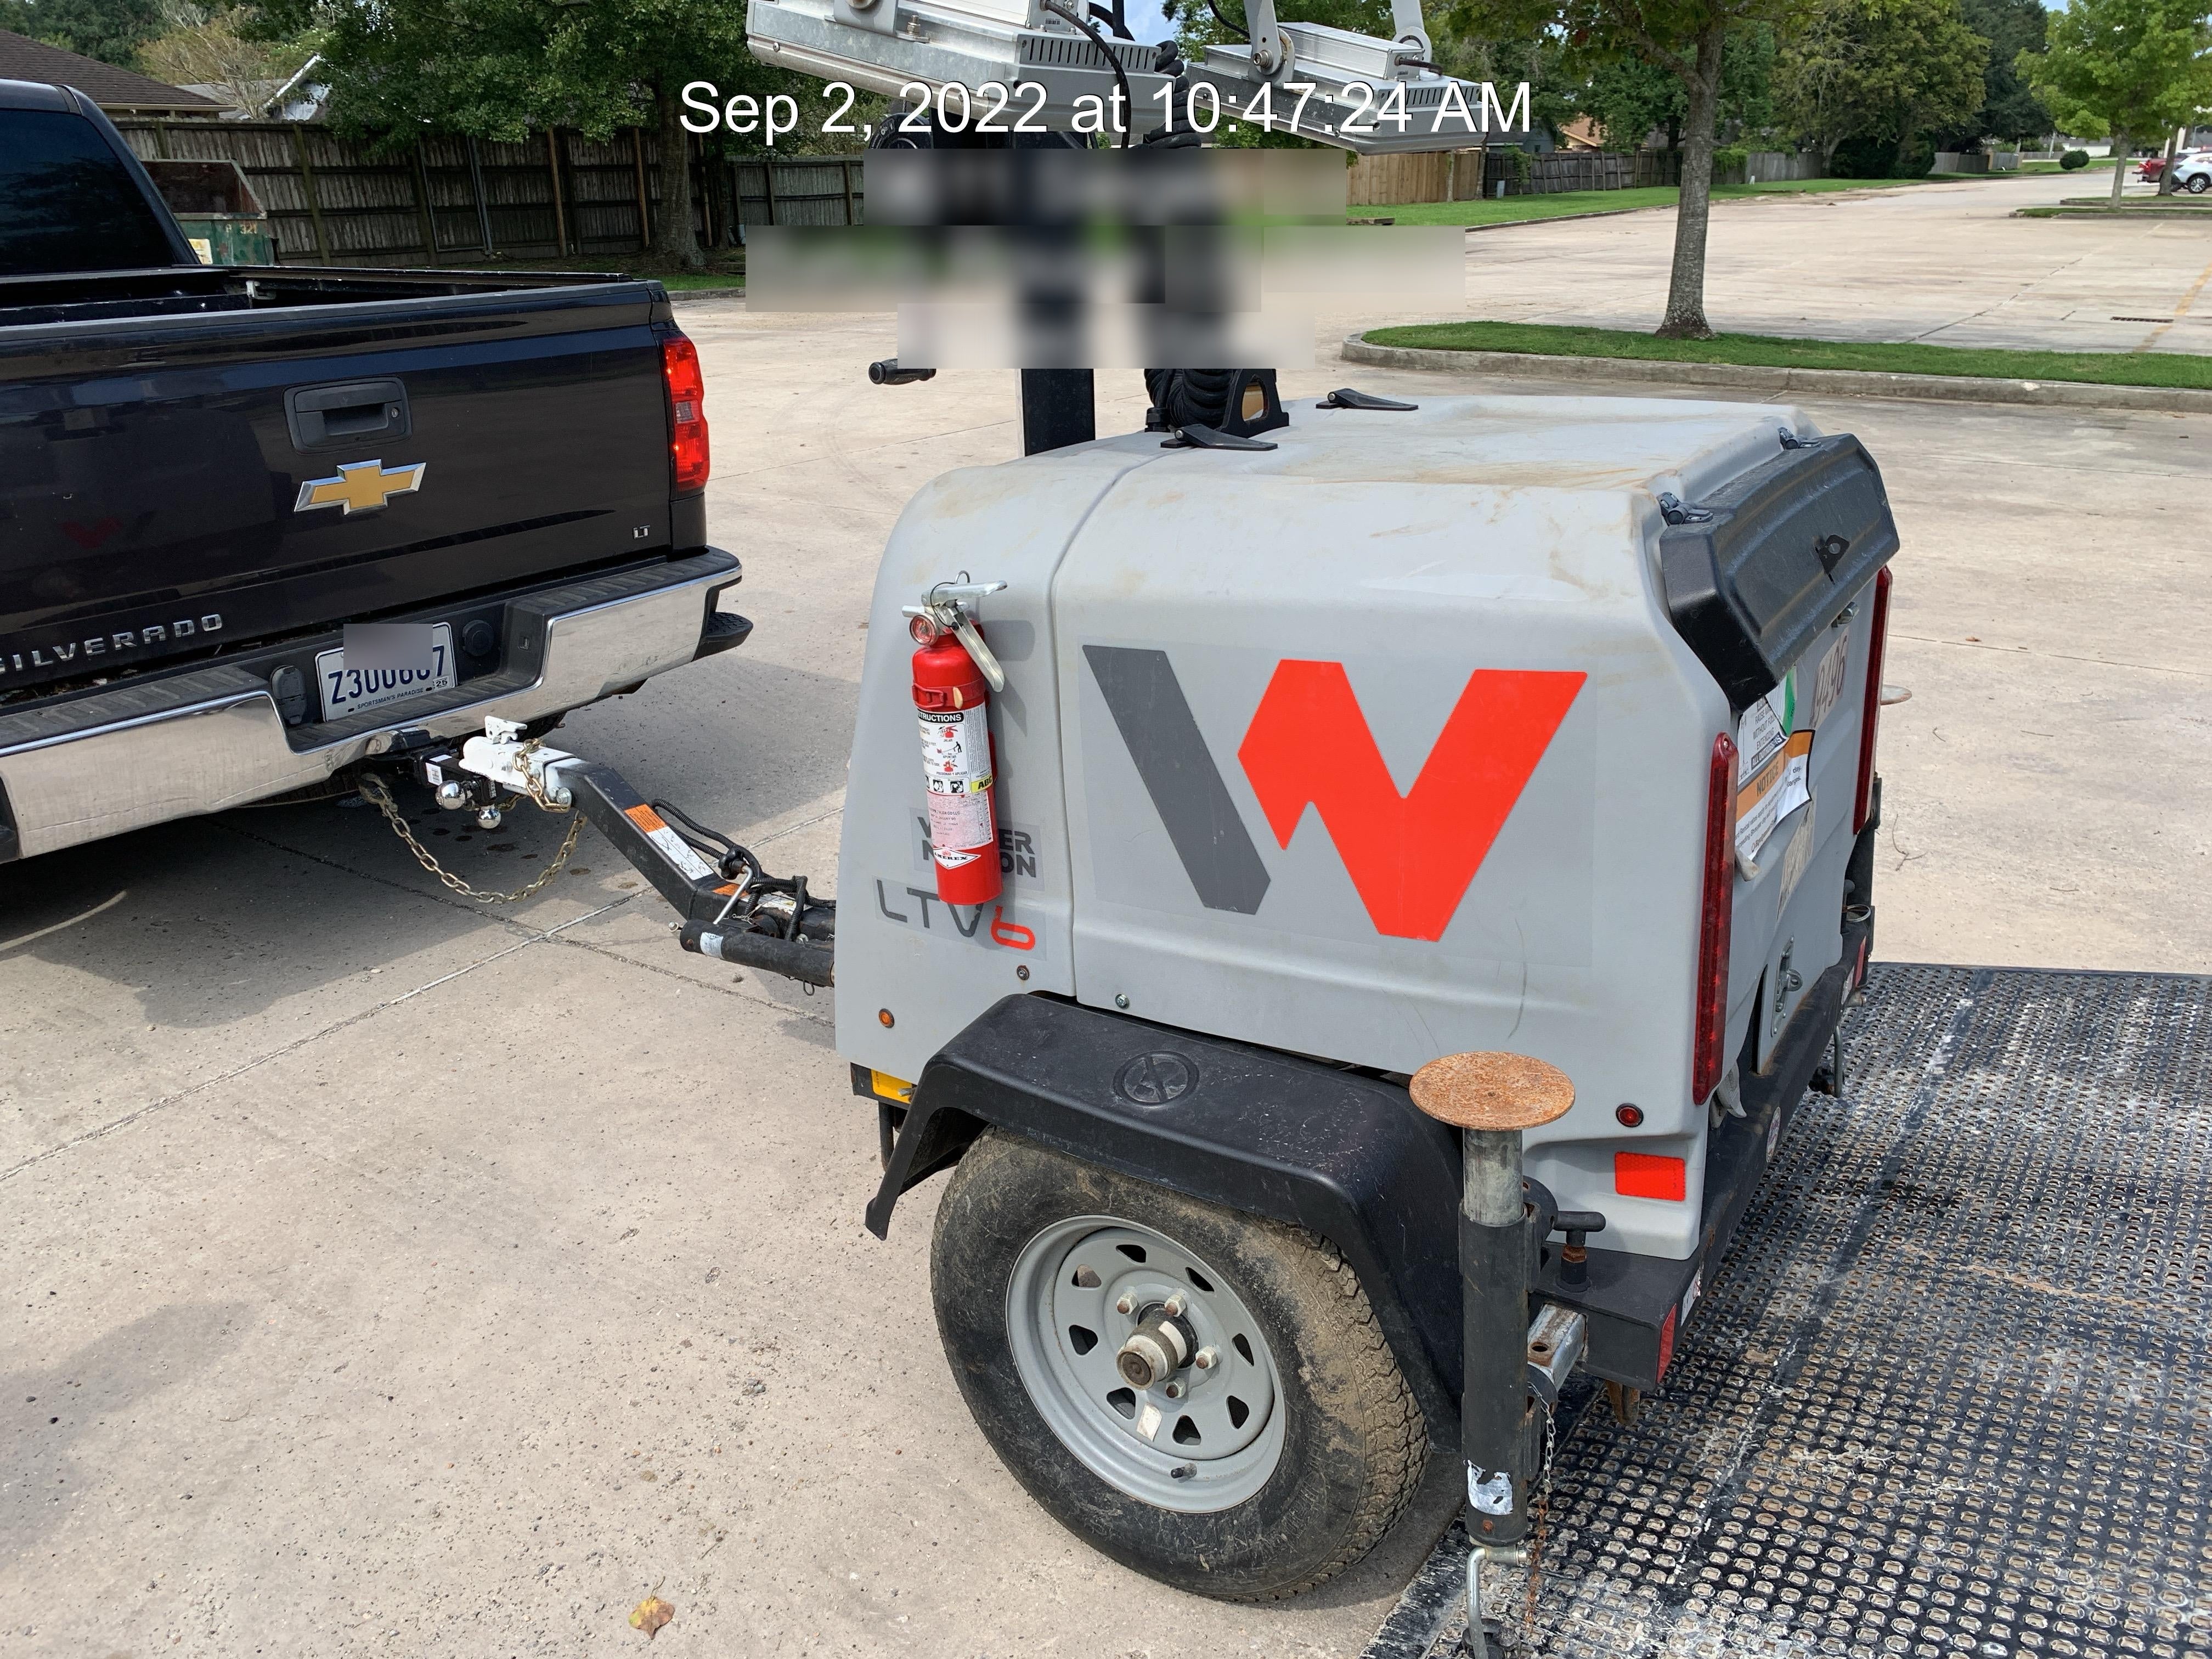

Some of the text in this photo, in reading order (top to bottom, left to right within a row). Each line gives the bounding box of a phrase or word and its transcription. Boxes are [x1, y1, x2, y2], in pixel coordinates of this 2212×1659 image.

[633, 524, 651, 539] LT
[0, 613, 222, 674] ILVERADO
[436, 679, 448, 687] 25
[357, 687, 424, 710] SPORTSMAN'S PARADISE
[1756, 762, 1779, 798] NOTICE
[876, 879, 1036, 951] LTV6
